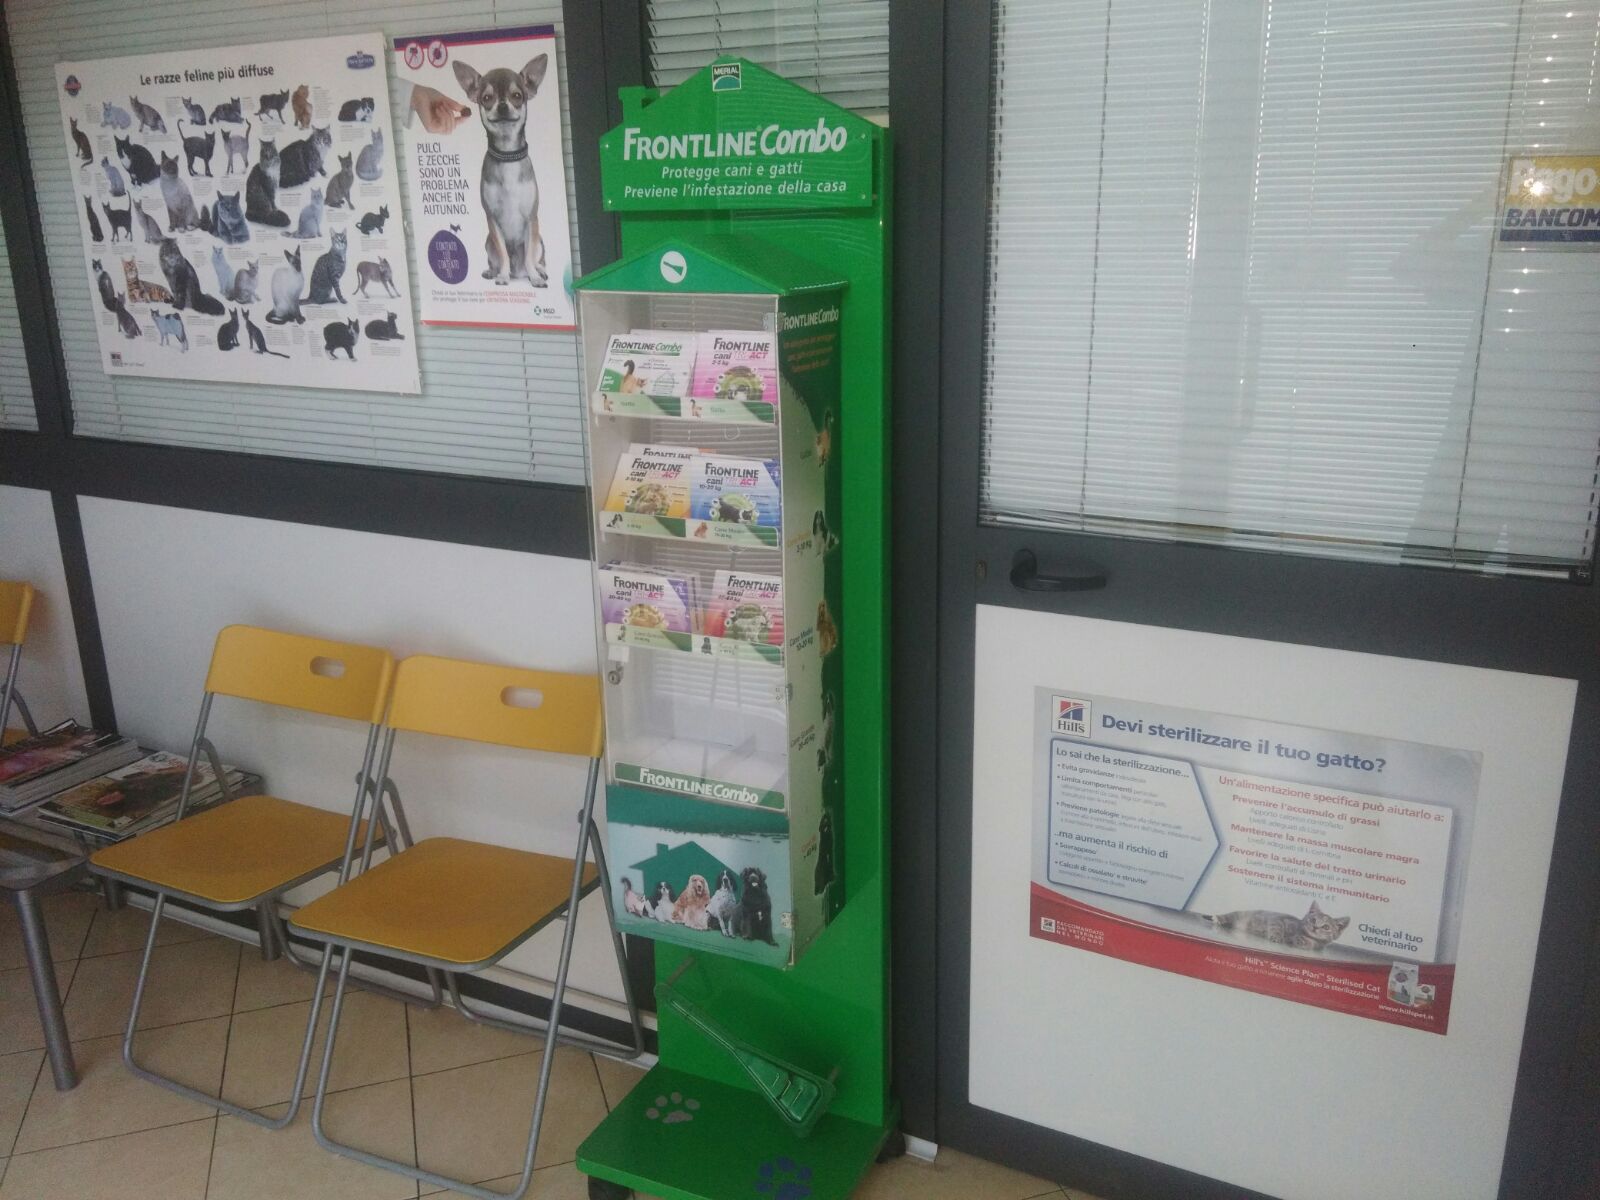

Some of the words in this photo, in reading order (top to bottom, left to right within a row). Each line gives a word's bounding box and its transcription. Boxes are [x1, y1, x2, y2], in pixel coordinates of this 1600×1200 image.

[140, 74, 151, 86] Le
[154, 73, 181, 85] razze
[184, 69, 214, 82] feline
[217, 66, 235, 83] più
[238, 64, 274, 79] diffuse
[714, 66, 739, 75] MERIAL
[623, 127, 757, 160] FRONTLINE
[760, 117, 848, 155] Combo
[416, 142, 441, 154] PULCI
[418, 155, 424, 166] E
[426, 154, 461, 166] ZECCHE
[419, 167, 445, 178] SONO
[447, 167, 461, 177] UN
[661, 166, 720, 181] Protegge
[724, 162, 752, 177] cani
[756, 165, 764, 176] e
[769, 160, 803, 178] gatti
[420, 179, 470, 191] PROBLEMA
[624, 185, 678, 198] Previene
[682, 181, 772, 197] l'infestazione
[778, 180, 811, 194] della
[816, 180, 847, 193] casa
[422, 192, 452, 203] ANCHE
[455, 192, 465, 202] IN
[423, 204, 470, 215] AUTUNNO.
[611, 338, 656, 351] FRONTLINE
[713, 337, 770, 351] FRONTLINE
[713, 352, 732, 360] cani
[632, 458, 683, 472] FRONTLINE
[705, 462, 759, 478] FRONTLINE
[706, 477, 723, 485] cani
[613, 576, 664, 593] FRONTLINE
[728, 575, 780, 592] FRONTLINE
[1058, 719, 1085, 734] Hill's
[1102, 714, 1143, 734] Devi
[1148, 724, 1251, 752] sterilizzare
[1257, 739, 1269, 755] il
[1275, 743, 1311, 762] tuo
[1316, 749, 1387, 773] gatto?
[1056, 747, 1067, 757] Lo
[1069, 750, 1082, 759] sai
[1084, 752, 1100, 762] che
[1102, 754, 1111, 764] la
[1113, 757, 1190, 778] sterilizzazione...
[1061, 764, 1078, 772] Evita
[639, 767, 713, 795] FRONTLINE
[713, 784, 759, 804] Combo
[1082, 778, 1133, 794] comportamenti
[1219, 775, 1311, 799] Un'alimentazione
[1313, 792, 1360, 810] specifica
[1362, 801, 1385, 812] può
[1387, 805, 1431, 820] aiutarlo
[1433, 813, 1445, 822] a:
[1089, 807, 1119, 819] patologie
[1232, 794, 1279, 808] Prevenire
[1281, 802, 1335, 819] l'accumulo
[1337, 812, 1347, 821] di
[1350, 816, 1380, 828] grassi
[1075, 834, 1116, 848] aumenta
[1126, 845, 1156, 857] rischio
[1158, 850, 1169, 859] di
[1231, 823, 1283, 839] Mantenere
[1286, 832, 1295, 842] la
[1297, 836, 1329, 848] massa
[1331, 842, 1383, 858] muscolare
[1386, 852, 1420, 865] magra
[1229, 845, 1269, 860] Favorire
[1271, 852, 1280, 862] la
[1282, 856, 1312, 869] salute
[1315, 862, 1330, 871] del
[1333, 866, 1362, 877] tratto
[1364, 871, 1407, 886] urinario
[1227, 864, 1275, 880] Sostenere
[1277, 874, 1284, 882] il
[1286, 877, 1324, 890] sistema
[1326, 884, 1390, 903] immunitario
[1358, 923, 1390, 937] Chiedi
[1393, 931, 1402, 939] al
[1405, 933, 1423, 943] tuo
[1361, 934, 1418, 952] veterinario
[1270, 962, 1299, 974] Science
[1326, 975, 1364, 989] Sterilised
[1366, 983, 1381, 993] Cat
